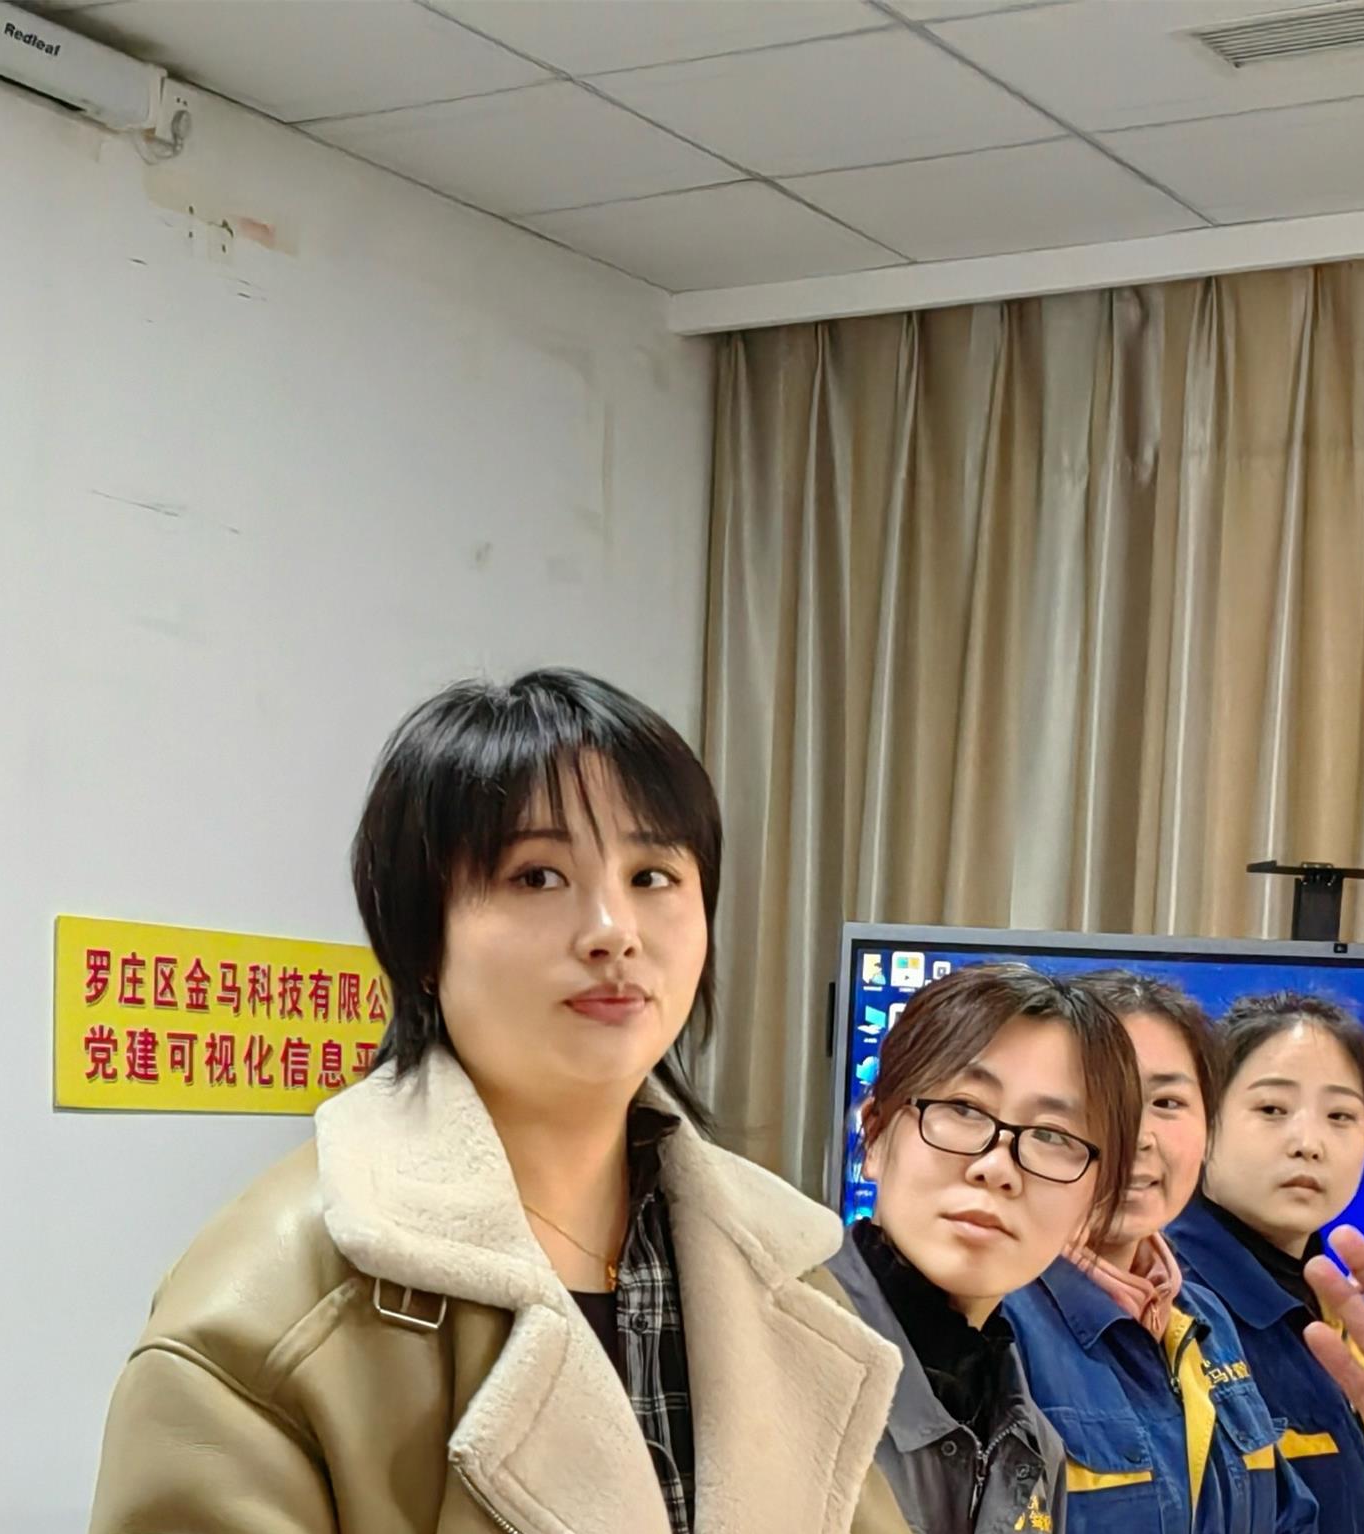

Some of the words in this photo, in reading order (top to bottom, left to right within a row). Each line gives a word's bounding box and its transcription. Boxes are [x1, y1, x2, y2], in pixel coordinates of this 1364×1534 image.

[4, 22, 61, 57] Redleaf
[85, 948, 388, 1022] 罗庄区金马科技有限公
